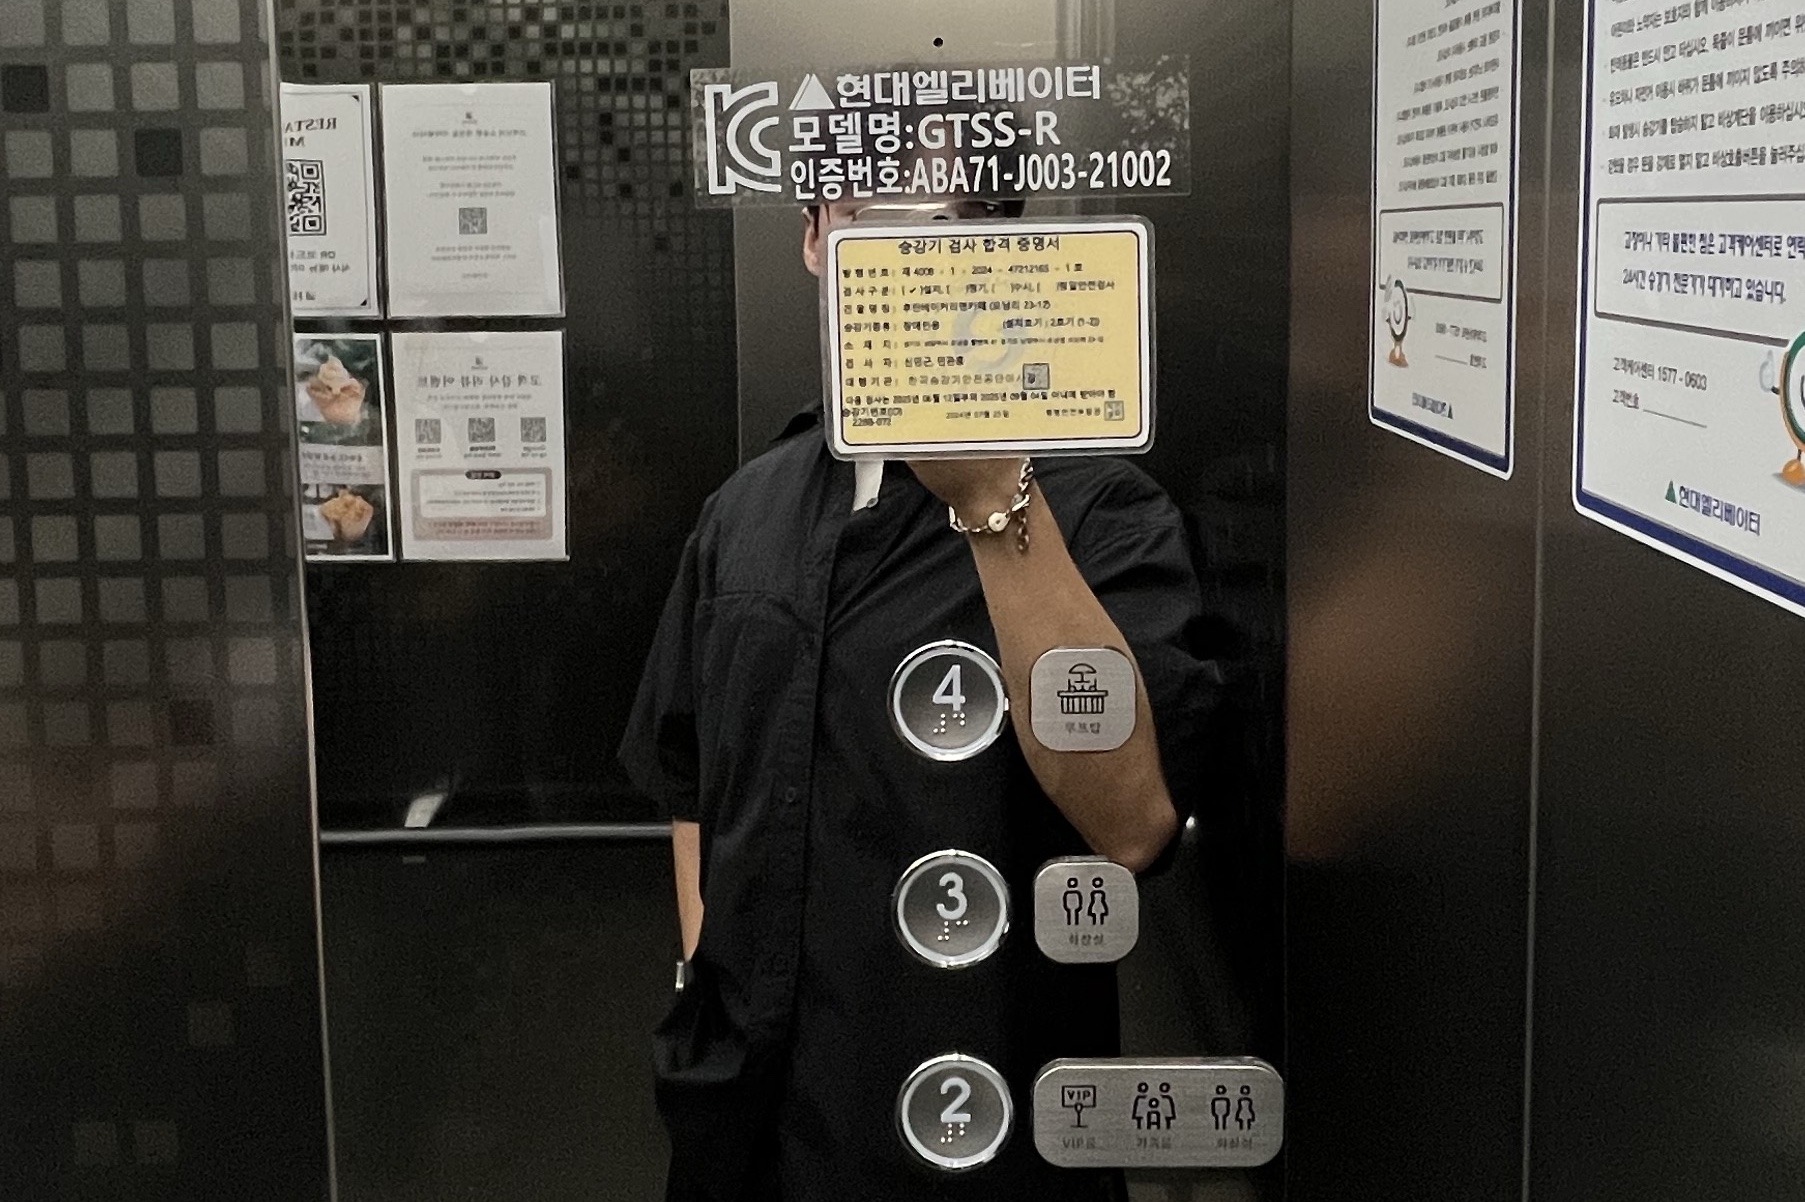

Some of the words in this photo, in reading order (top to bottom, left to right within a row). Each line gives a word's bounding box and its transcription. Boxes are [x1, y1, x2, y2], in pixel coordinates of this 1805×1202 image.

[836, 66, 1100, 108] 현대엘리베이터
[898, 238, 942, 255] 승강기
[949, 237, 977, 254] 검사
[983, 237, 1010, 252] 합격
[1017, 236, 1060, 251] 증명서
[1655, 231, 1670, 252] 기타
[1649, 270, 1671, 293] 승강기
[1657, 365, 1678, 385] 1577
[1678, 485, 1761, 537] 현대엘리베이터
[932, 664, 966, 712] 4
[936, 872, 968, 920] 3
[940, 1076, 971, 1123] 2
[1067, 1090, 1091, 1100] VIP
